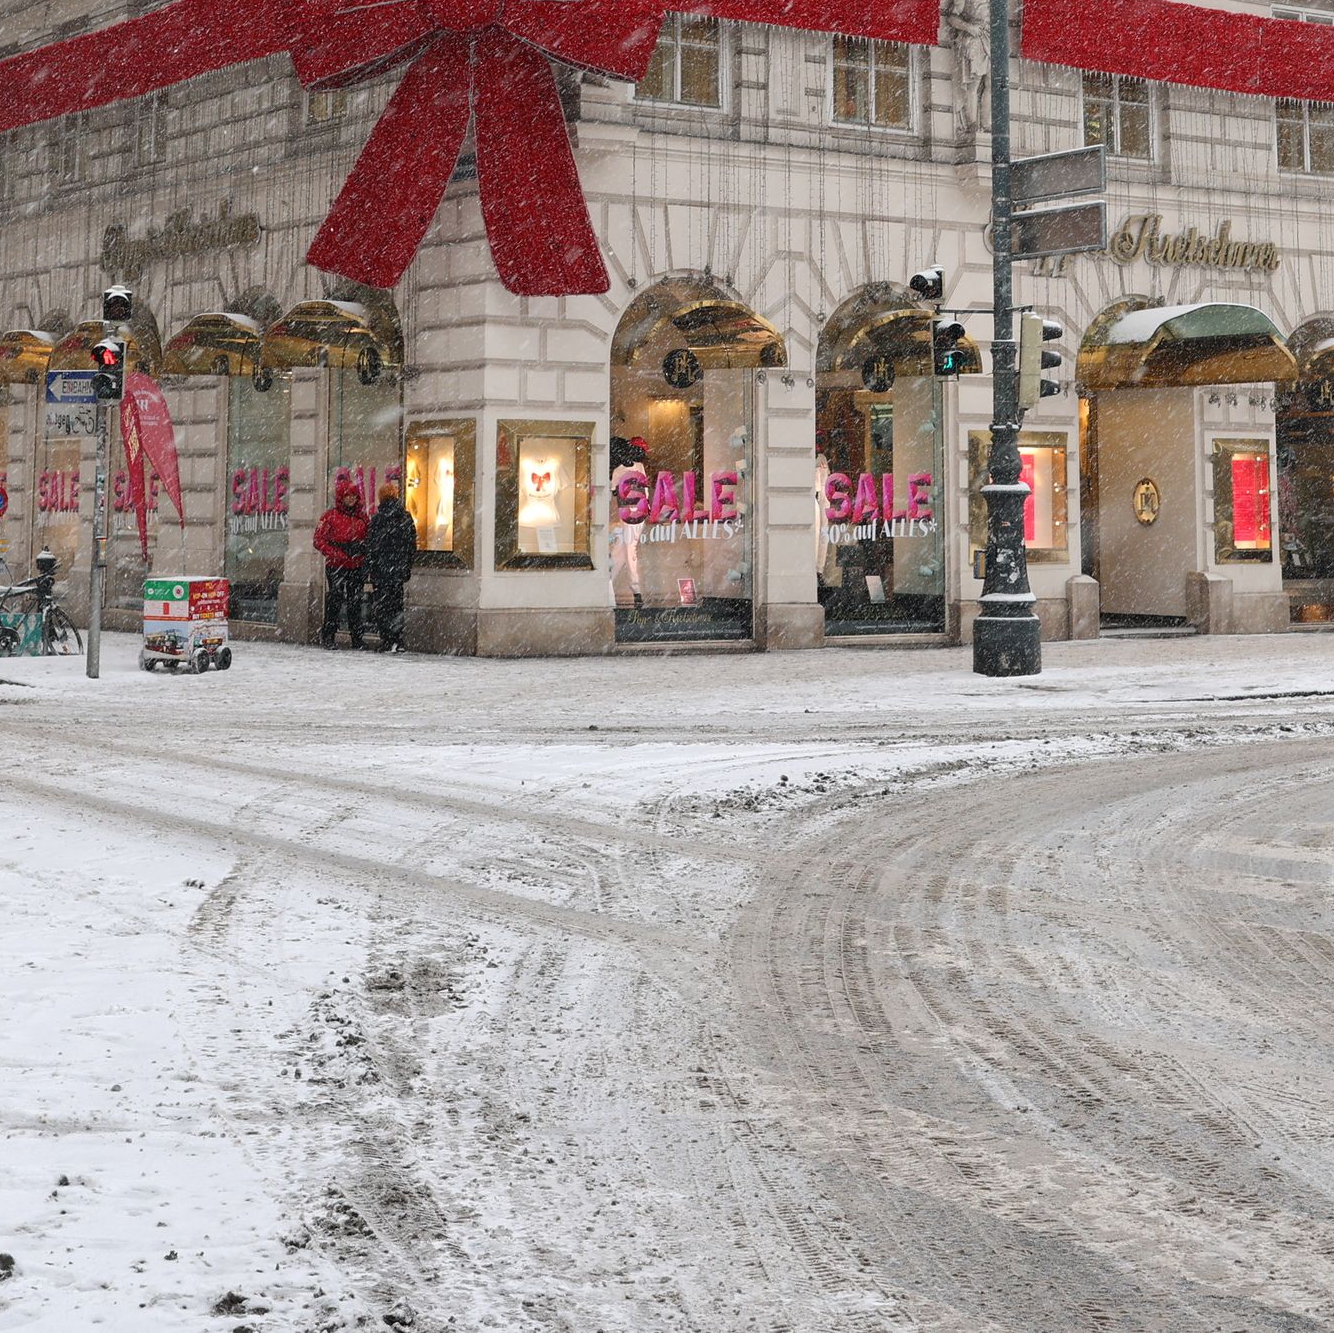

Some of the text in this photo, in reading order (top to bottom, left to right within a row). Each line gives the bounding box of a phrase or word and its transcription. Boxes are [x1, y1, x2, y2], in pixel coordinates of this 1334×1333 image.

[39, 469, 80, 512] SALE
[230, 467, 290, 515] SALE
[618, 470, 738, 524] SALE
[825, 472, 932, 523] SALE
[649, 519, 677, 543] auf
[852, 518, 878, 542] auf
